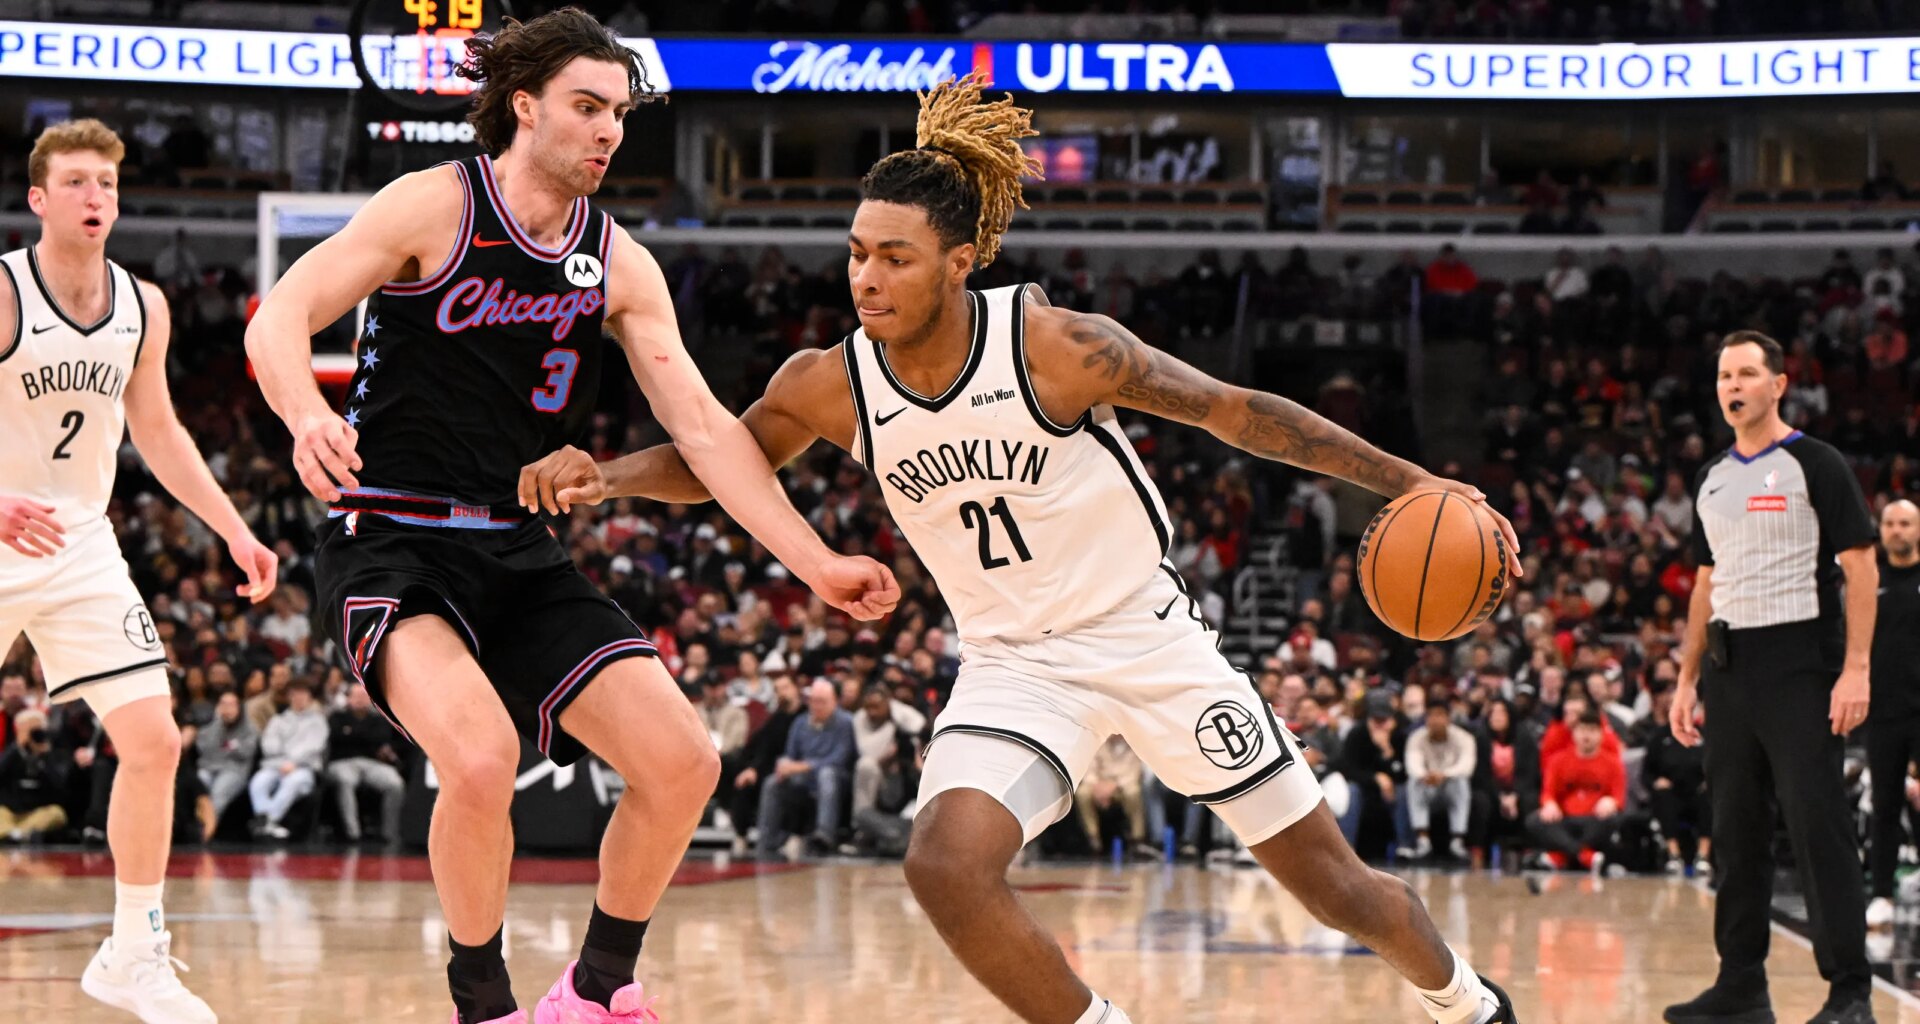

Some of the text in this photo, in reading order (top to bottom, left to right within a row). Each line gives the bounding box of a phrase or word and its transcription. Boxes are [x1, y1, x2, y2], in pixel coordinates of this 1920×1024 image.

[404, 0, 482, 28] 4:19
[0, 32, 207, 72] PERIOR
[752, 41, 1235, 94] Michelob ULTRA
[1411, 52, 1692, 88] SUPERIOR
[1720, 48, 1880, 86] LIGHT
[400, 121, 476, 142] TISSO
[436, 277, 605, 341] Chicago
[21, 360, 124, 403] BROOKLYN
[531, 348, 580, 413] 3
[971, 388, 1016, 408] All In Won
[52, 410, 84, 460] 2
[886, 439, 1049, 503] BROOKLYN
[453, 505, 489, 518] BULLS
[959, 496, 1033, 570] 21
[1211, 712, 1248, 760] B
